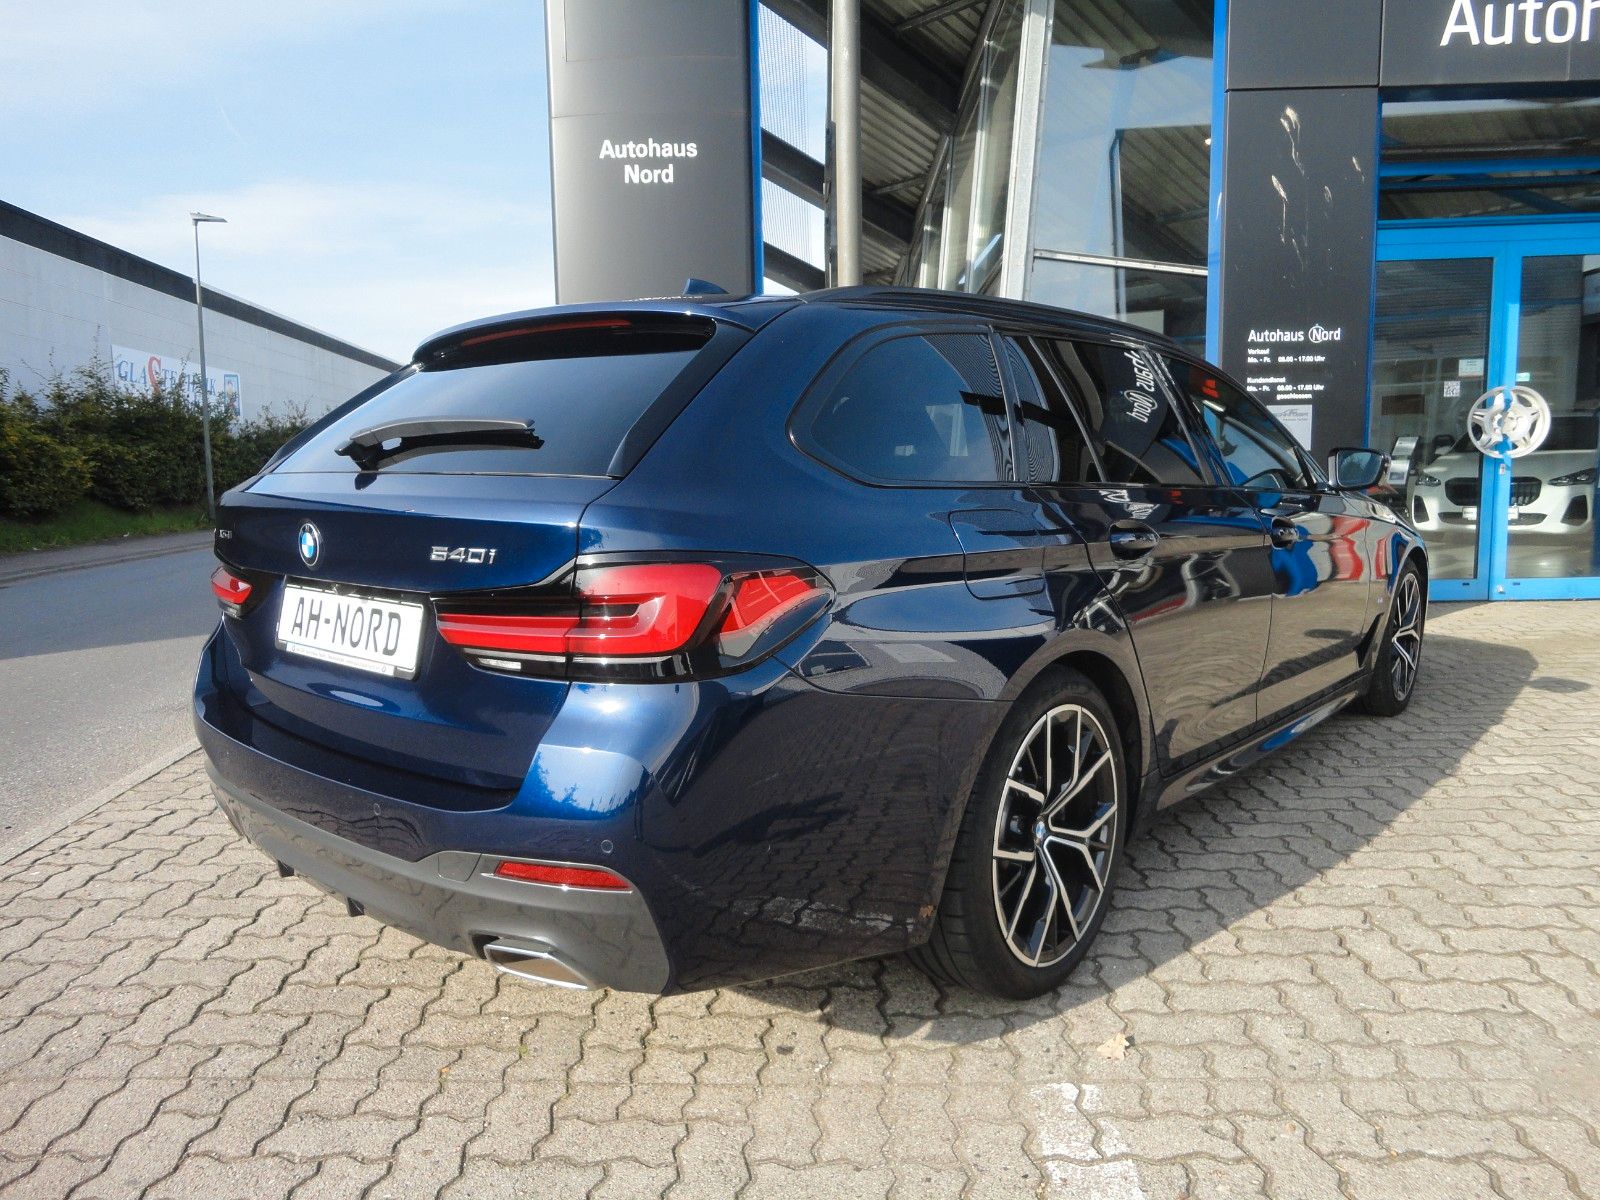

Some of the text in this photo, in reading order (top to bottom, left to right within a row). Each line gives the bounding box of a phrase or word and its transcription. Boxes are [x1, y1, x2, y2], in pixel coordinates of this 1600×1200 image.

[599, 137, 698, 159] Autohaus
[624, 163, 674, 184] Nord
[1247, 325, 1341, 343] Autohaus Nord
[430, 546, 497, 565] 540i
[291, 596, 402, 657] AH-NORD
